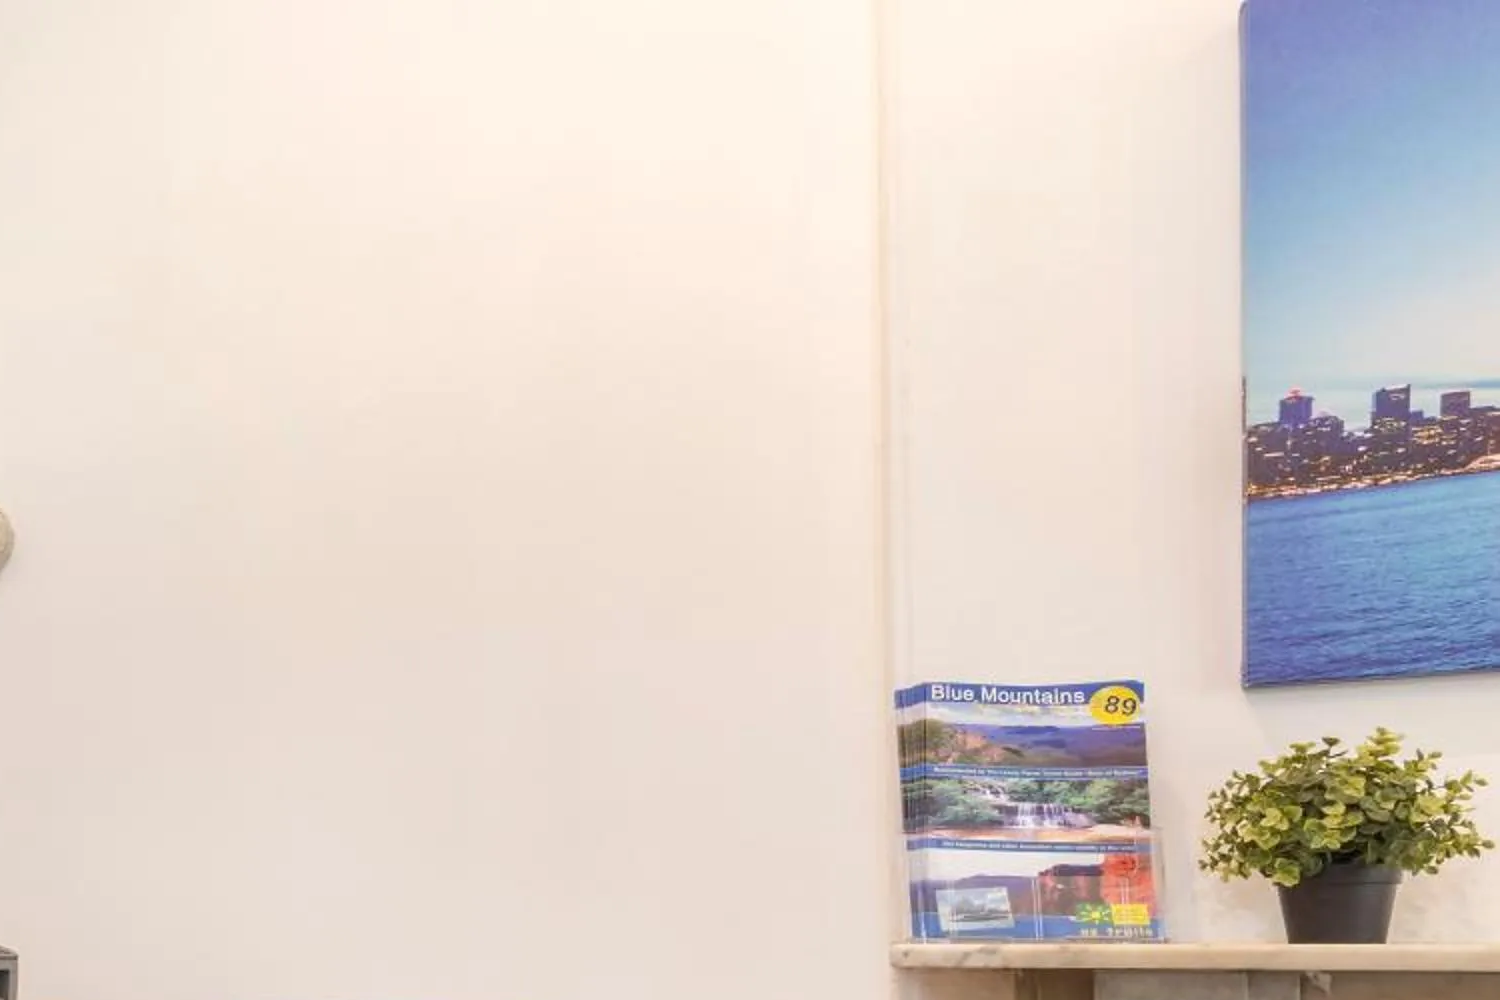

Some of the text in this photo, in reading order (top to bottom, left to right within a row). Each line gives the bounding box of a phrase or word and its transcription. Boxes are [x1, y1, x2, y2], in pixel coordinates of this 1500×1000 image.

[931, 684, 1085, 705] Blue Mountains
[1104, 695, 1137, 716] 89
